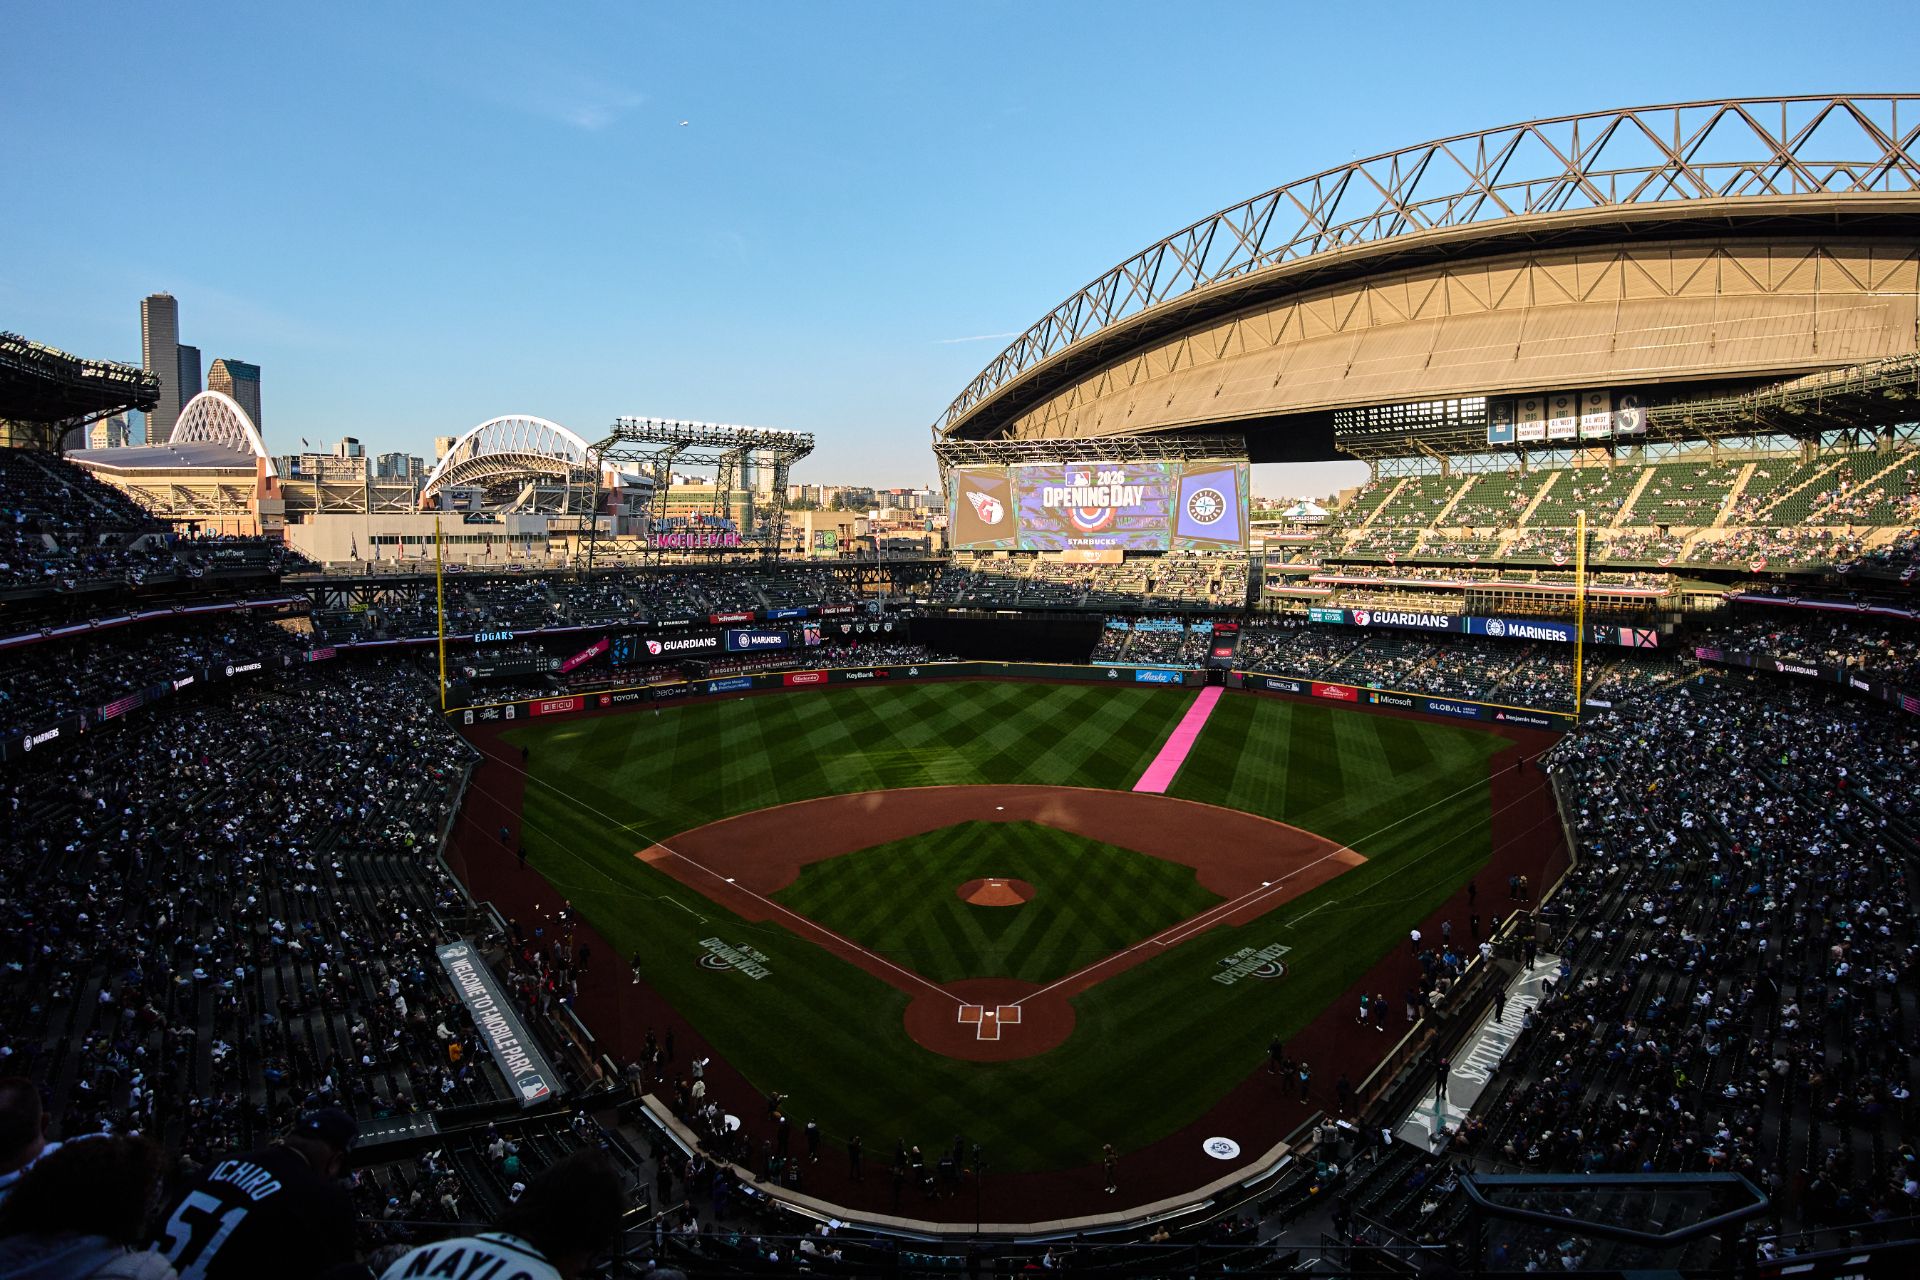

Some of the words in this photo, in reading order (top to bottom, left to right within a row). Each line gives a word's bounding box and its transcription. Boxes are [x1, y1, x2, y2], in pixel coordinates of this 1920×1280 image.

[1097, 471, 1125, 485] 2026
[1043, 487, 1110, 508] OPENING
[1111, 485, 1144, 507] DAY
[646, 533, 706, 548] T-MOBILE
[708, 532, 742, 547] PARK
[1372, 611, 1449, 631] GUARDIANS
[751, 636, 782, 645] MARINERS
[1508, 623, 1567, 643] MARINERS
[663, 637, 717, 651] GUARDIANS
[235, 662, 262, 673] MARINERS
[1784, 664, 1818, 678] GUARDIANS
[846, 671, 873, 680] KeyBank
[1138, 671, 1167, 682] Alaska
[613, 693, 639, 702] TOYOTA
[1380, 695, 1412, 707] Microsoft
[543, 701, 572, 712] BECU
[1429, 702, 1462, 714] GLOBAL
[1505, 714, 1530, 724] Benjamin
[1530, 717, 1549, 726] Moore
[33, 727, 60, 746] MARINERS
[698, 936, 748, 964] OPENING
[450, 957, 487, 998] WELCOME
[1211, 956, 1268, 985] OPENING
[472, 994, 494, 1009] TO
[479, 1005, 519, 1050] T-MOBILE
[500, 1044, 536, 1078] PARK
[208, 1159, 282, 1202] ICHIRO
[163, 1189, 250, 1280] 51
